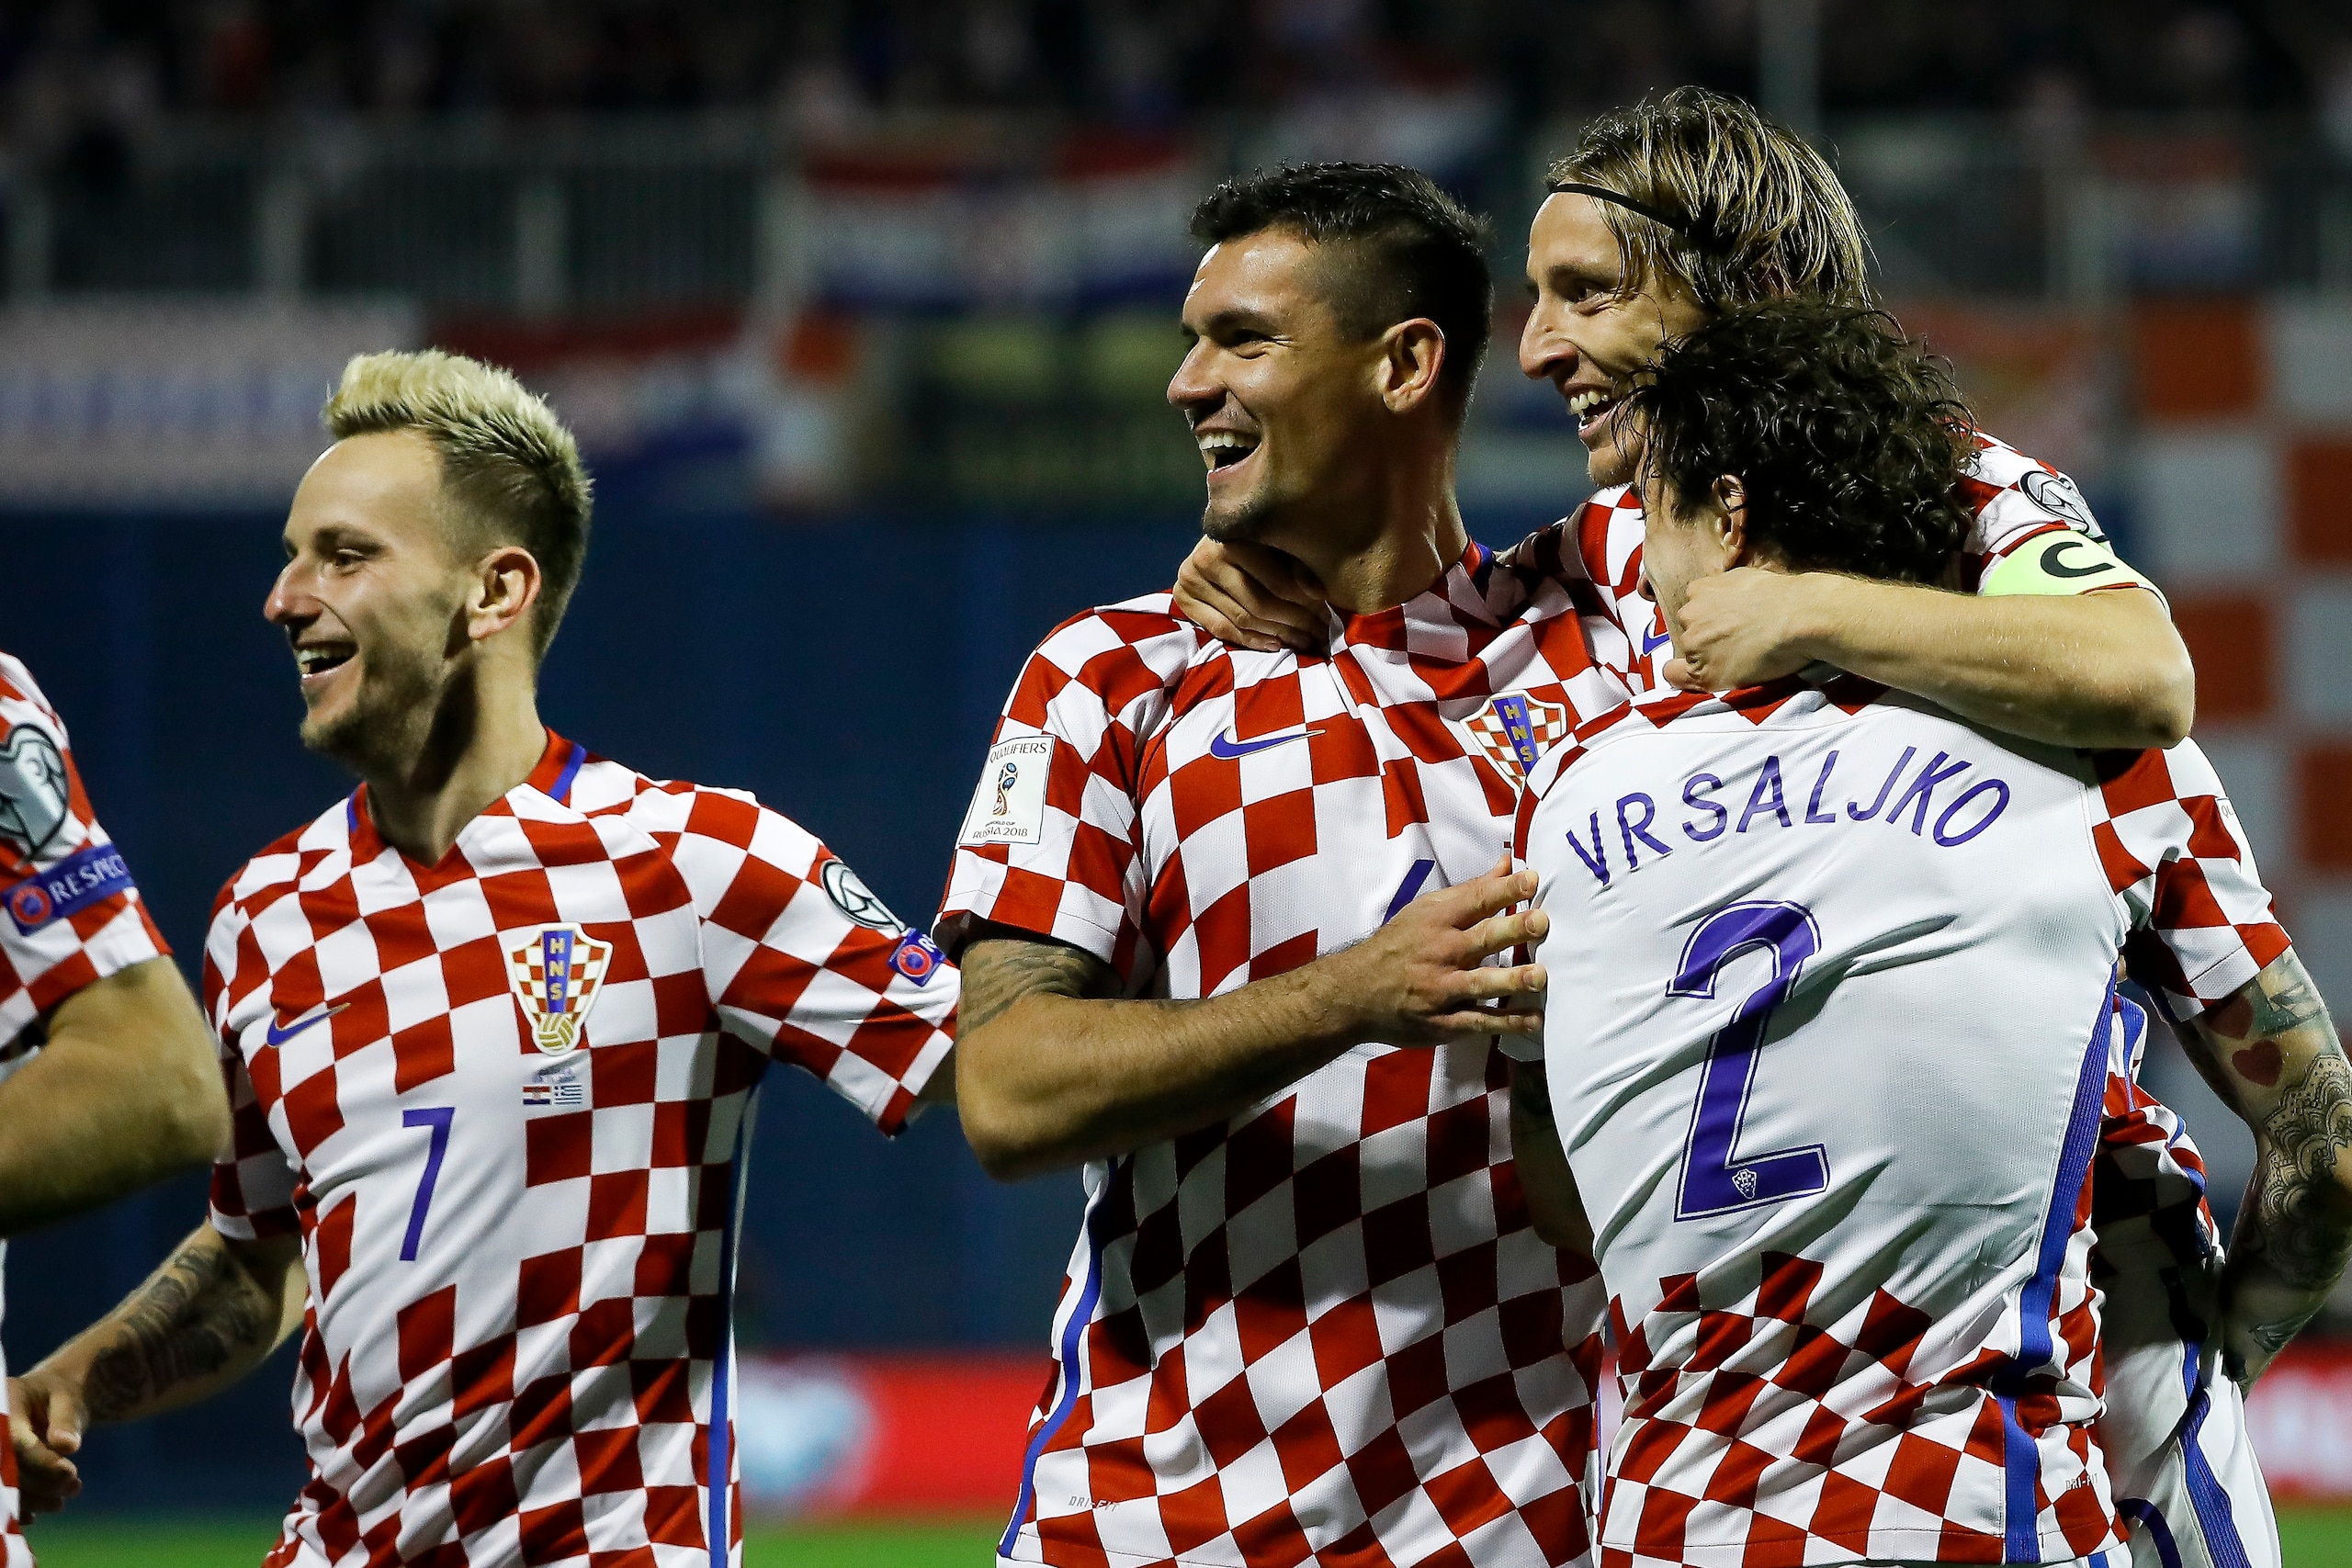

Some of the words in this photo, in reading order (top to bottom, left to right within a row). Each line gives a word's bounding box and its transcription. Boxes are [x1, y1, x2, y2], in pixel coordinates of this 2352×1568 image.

[2041, 541, 2116, 578] C
[989, 742, 1047, 763] QUALIFIERS
[1503, 704, 1533, 762] HNS
[1003, 827, 1028, 837] 2018
[1566, 746, 2010, 886] VRSALJKO
[548, 937, 567, 1001] HNS
[1665, 899, 1831, 1223] 2
[399, 1107, 455, 1261] 7
